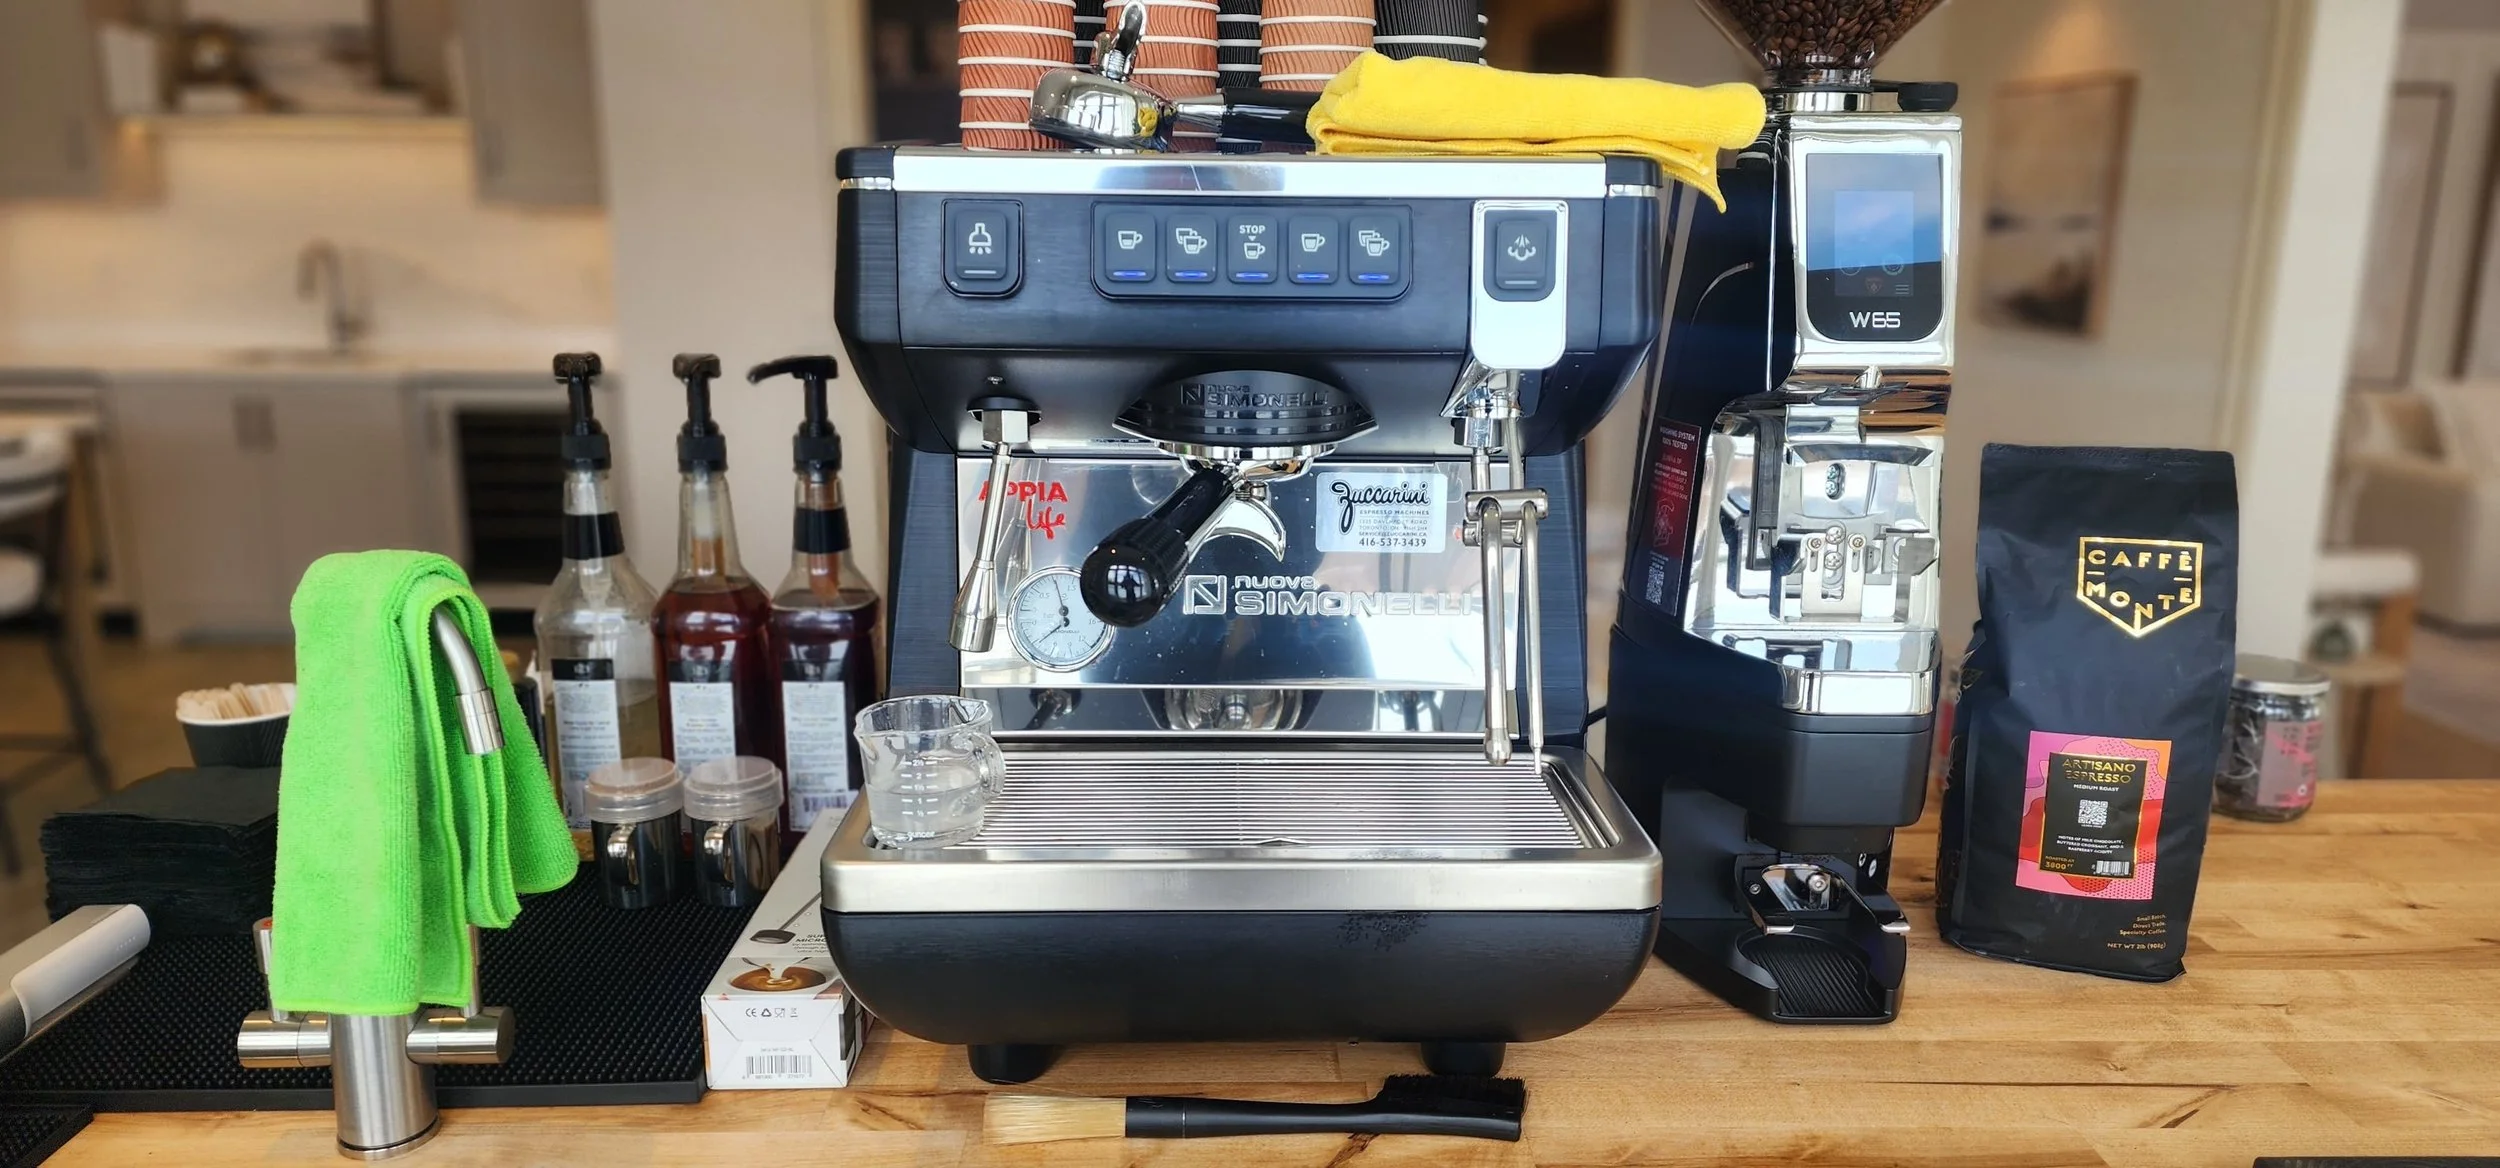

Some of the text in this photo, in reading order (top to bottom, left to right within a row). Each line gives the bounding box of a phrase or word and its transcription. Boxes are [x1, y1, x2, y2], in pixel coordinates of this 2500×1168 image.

[1239, 224, 1266, 234] STOP
[1849, 311, 1901, 328] W65
[1207, 391, 1329, 408] SIMONELLI
[1678, 431, 1695, 442] SYSTEM
[1672, 440, 1688, 450] TESTED
[1331, 482, 1429, 533] Zuccarini
[1359, 538, 1427, 547] 416-537-3439
[1234, 591, 1471, 616] SIMONELLI
[2086, 581, 2193, 628] MONTE
[2062, 759, 2136, 773] ARTISANO
[2065, 770, 2131, 783] ESPRESSO
